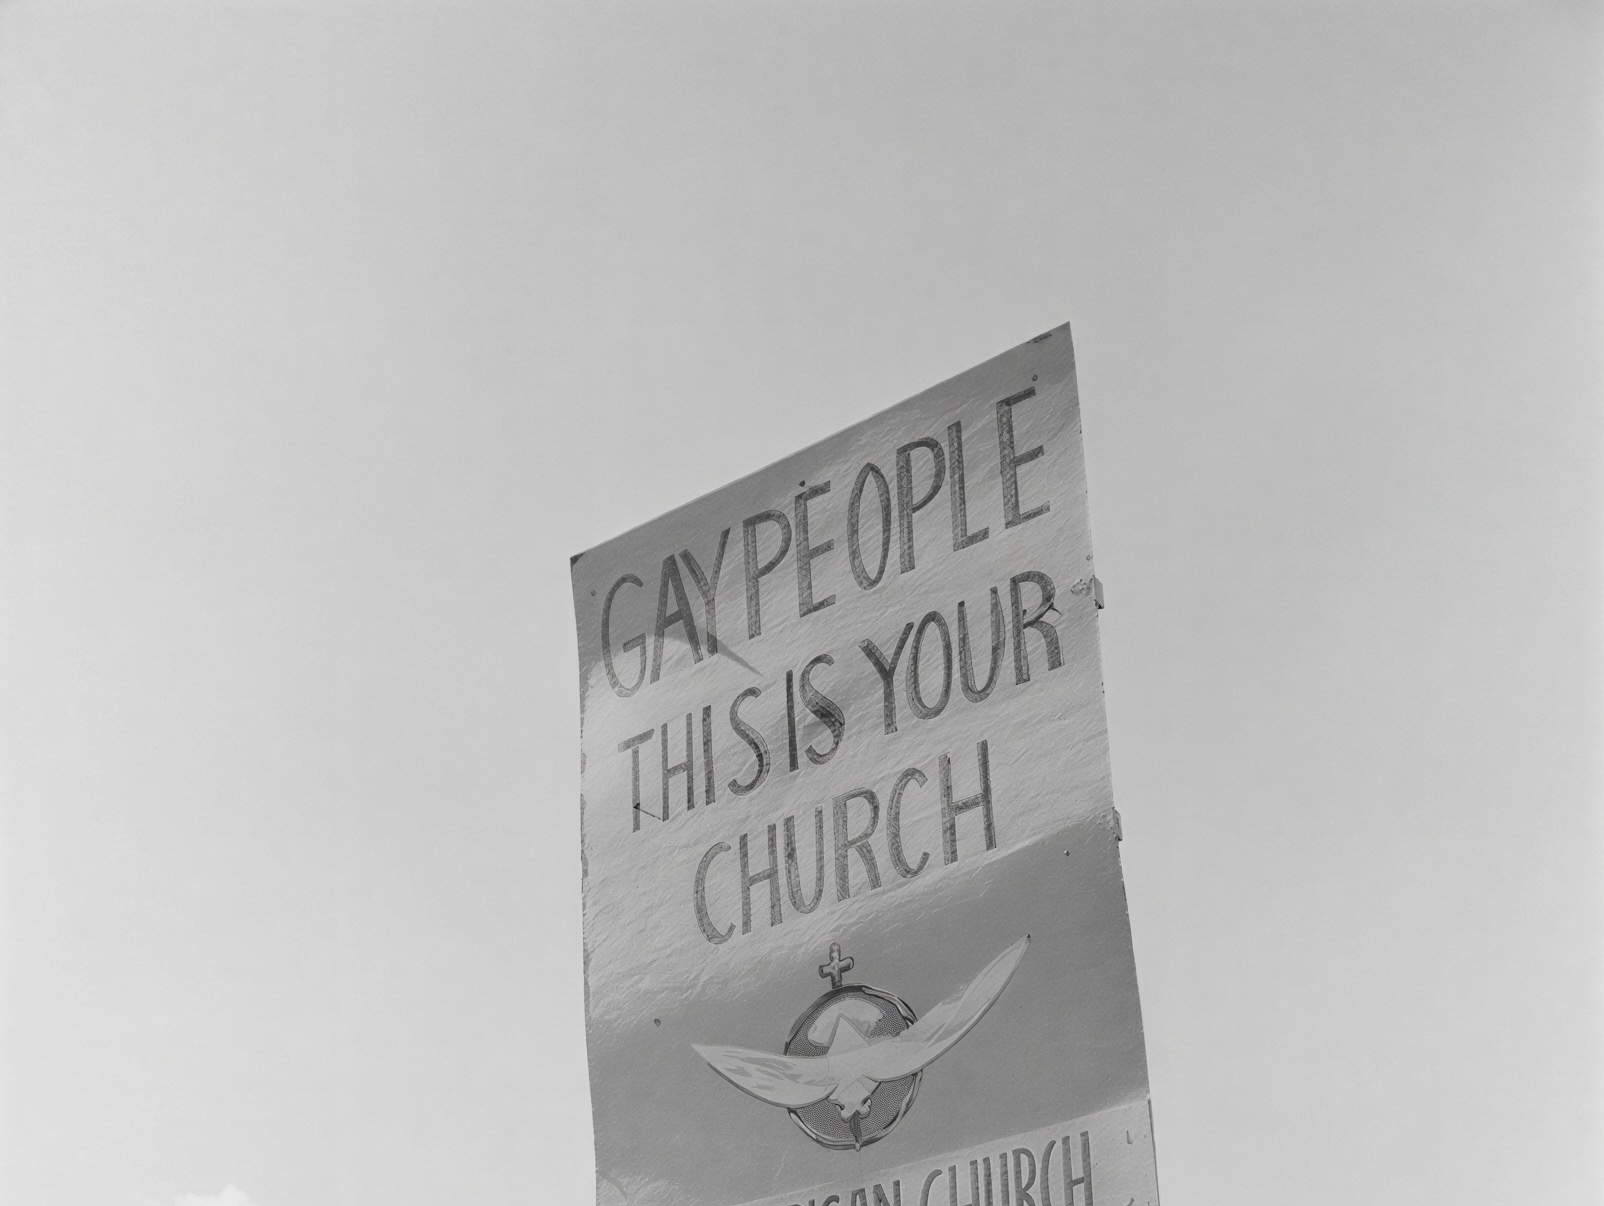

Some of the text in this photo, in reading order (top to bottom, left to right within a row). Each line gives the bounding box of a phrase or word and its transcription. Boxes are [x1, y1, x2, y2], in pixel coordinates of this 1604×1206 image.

[602, 386, 1050, 697] GAY PEOPLE
[618, 570, 1065, 833] THIS IS YOUR
[693, 739, 997, 945] CHURCH
